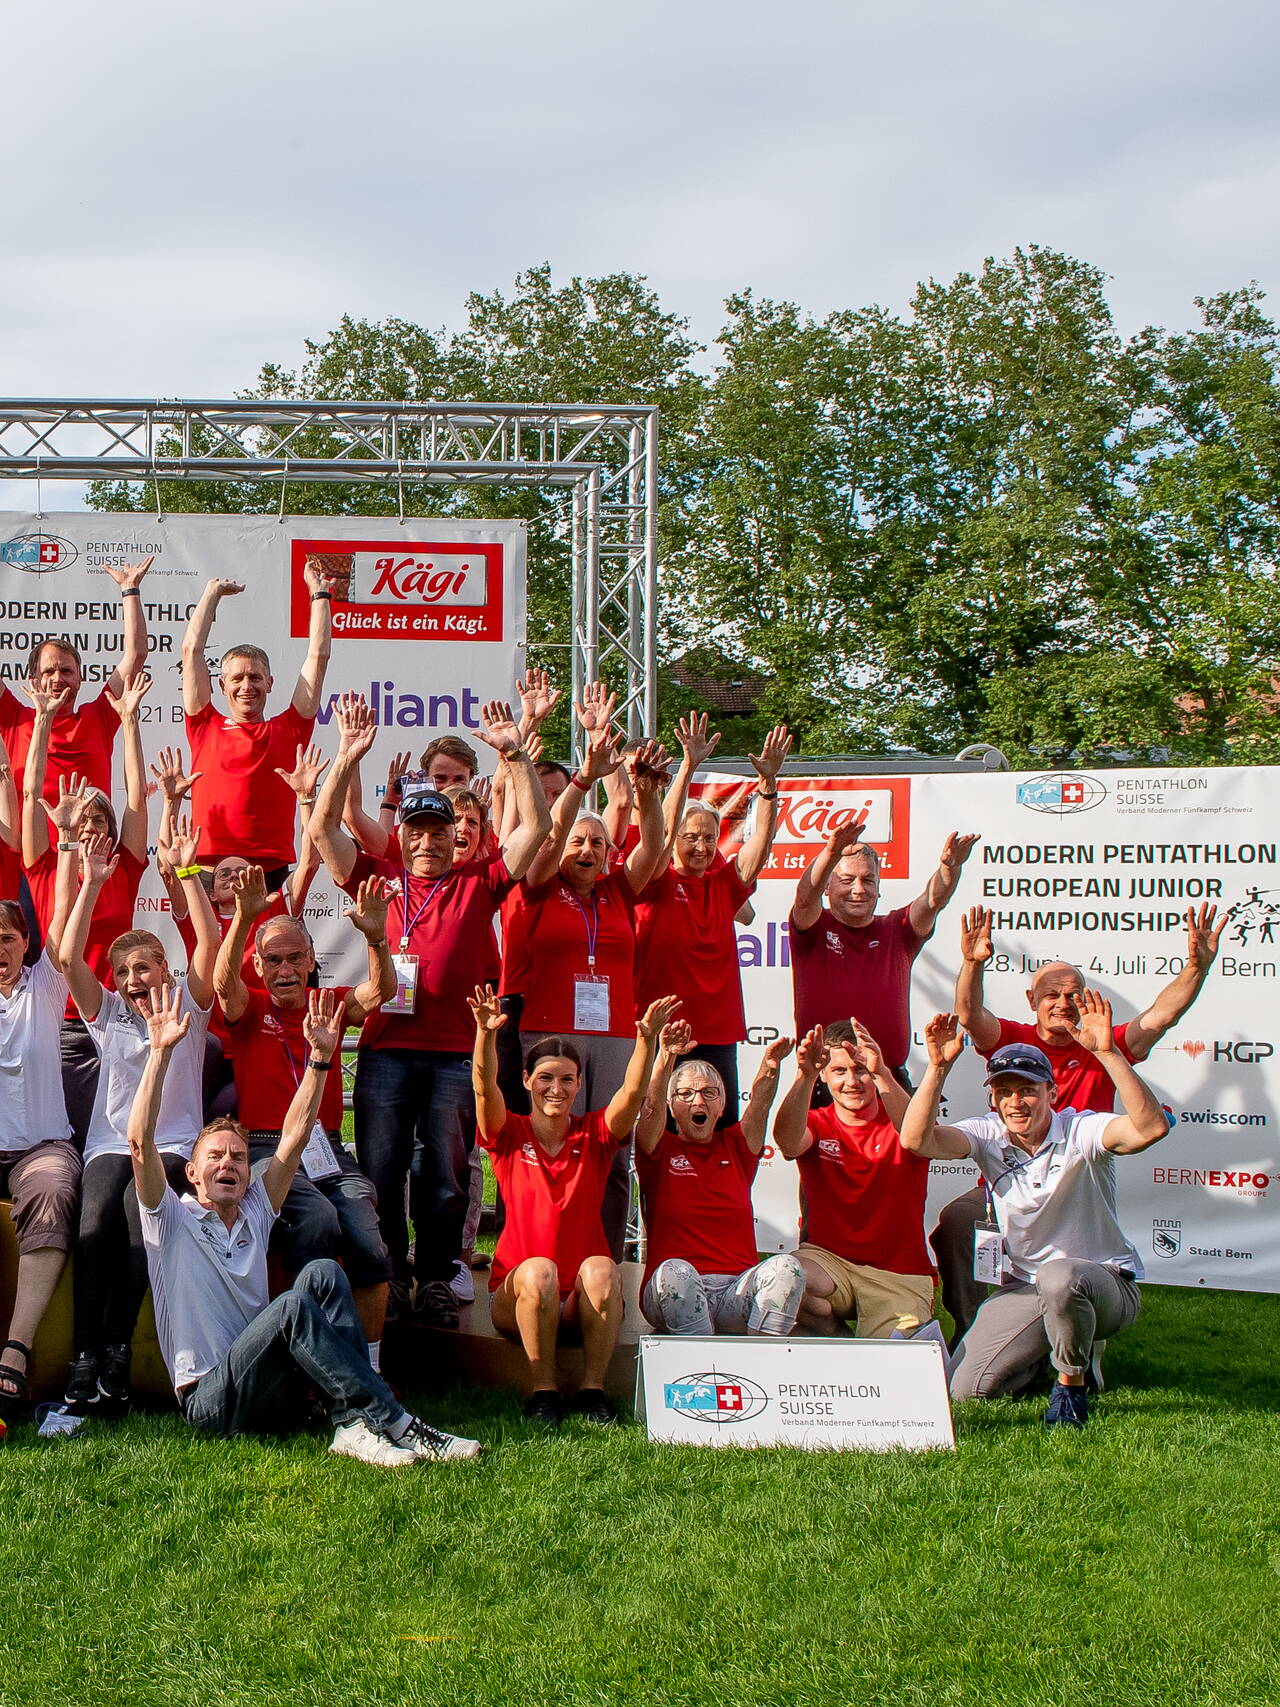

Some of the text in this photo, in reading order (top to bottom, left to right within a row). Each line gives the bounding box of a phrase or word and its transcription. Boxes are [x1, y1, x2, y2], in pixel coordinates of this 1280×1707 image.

[86, 542, 162, 553] PENTATHLON
[86, 556, 126, 566] SUISSE
[370, 558, 469, 602] Kägi
[74, 602, 216, 622] PENTHL
[332, 613, 488, 635] Glück ist ein Kägi.
[96, 633, 173, 653] JUOR
[316, 681, 480, 728] vliant
[1116, 778, 1208, 790] PENTATHLON
[1116, 793, 1165, 805] SUISSE
[776, 796, 872, 839] Kägi
[783, 853, 807, 869] ist
[982, 843, 1277, 864] MODERN PENTATHLON
[982, 878, 1222, 899] EUROPEAN JUNIOR
[983, 954, 1015, 972] 28.
[1020, 954, 1060, 974] Ju
[1089, 956, 1109, 974] 4.
[1113, 955, 1146, 975] Juli
[1155, 956, 1191, 976] 20
[1222, 957, 1276, 977] Bern
[742, 1026, 780, 1046] GP
[1213, 1040, 1274, 1063] KGP
[1180, 1111, 1267, 1127] swisscom
[928, 1164, 978, 1176] upporter
[1153, 1167, 1269, 1189] BERNEXPO
[1189, 1246, 1253, 1260] Stadt Bern
[778, 1384, 881, 1399] PENTATHLON
[779, 1401, 834, 1416] SUISSE
[781, 1418, 814, 1427] Verband
[816, 1419, 855, 1427] Moderner
[901, 1419, 935, 1428] Schweiz
